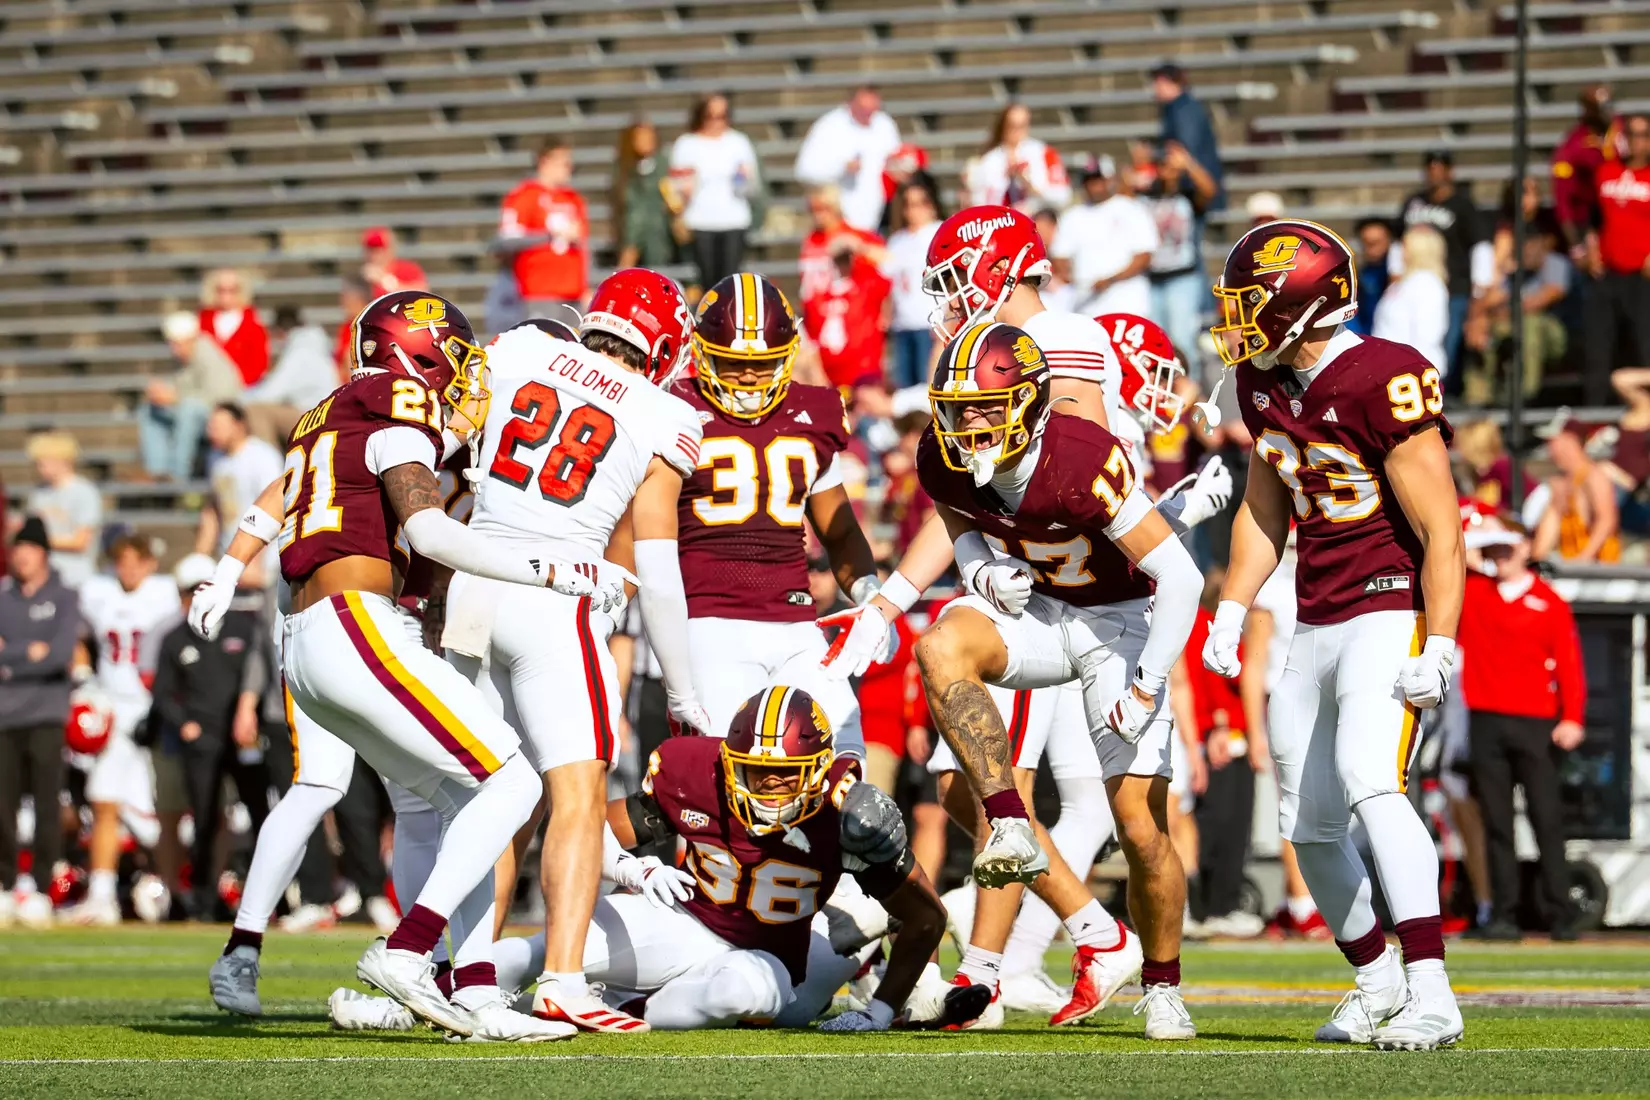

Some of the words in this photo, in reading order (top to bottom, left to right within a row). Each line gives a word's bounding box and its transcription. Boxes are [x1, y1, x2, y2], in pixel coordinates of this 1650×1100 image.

[957, 212, 1016, 243] Miami
[1112, 319, 1146, 348] 14
[391, 379, 442, 436] 21
[548, 353, 628, 404] COLOMBI
[1386, 368, 1443, 422] 93
[293, 396, 335, 441] ALLEN
[489, 380, 617, 508] 28
[279, 430, 344, 555] 21
[692, 435, 820, 527] 30
[1091, 444, 1135, 518] 17
[1256, 428, 1383, 523] 93
[686, 840, 822, 925] 36
